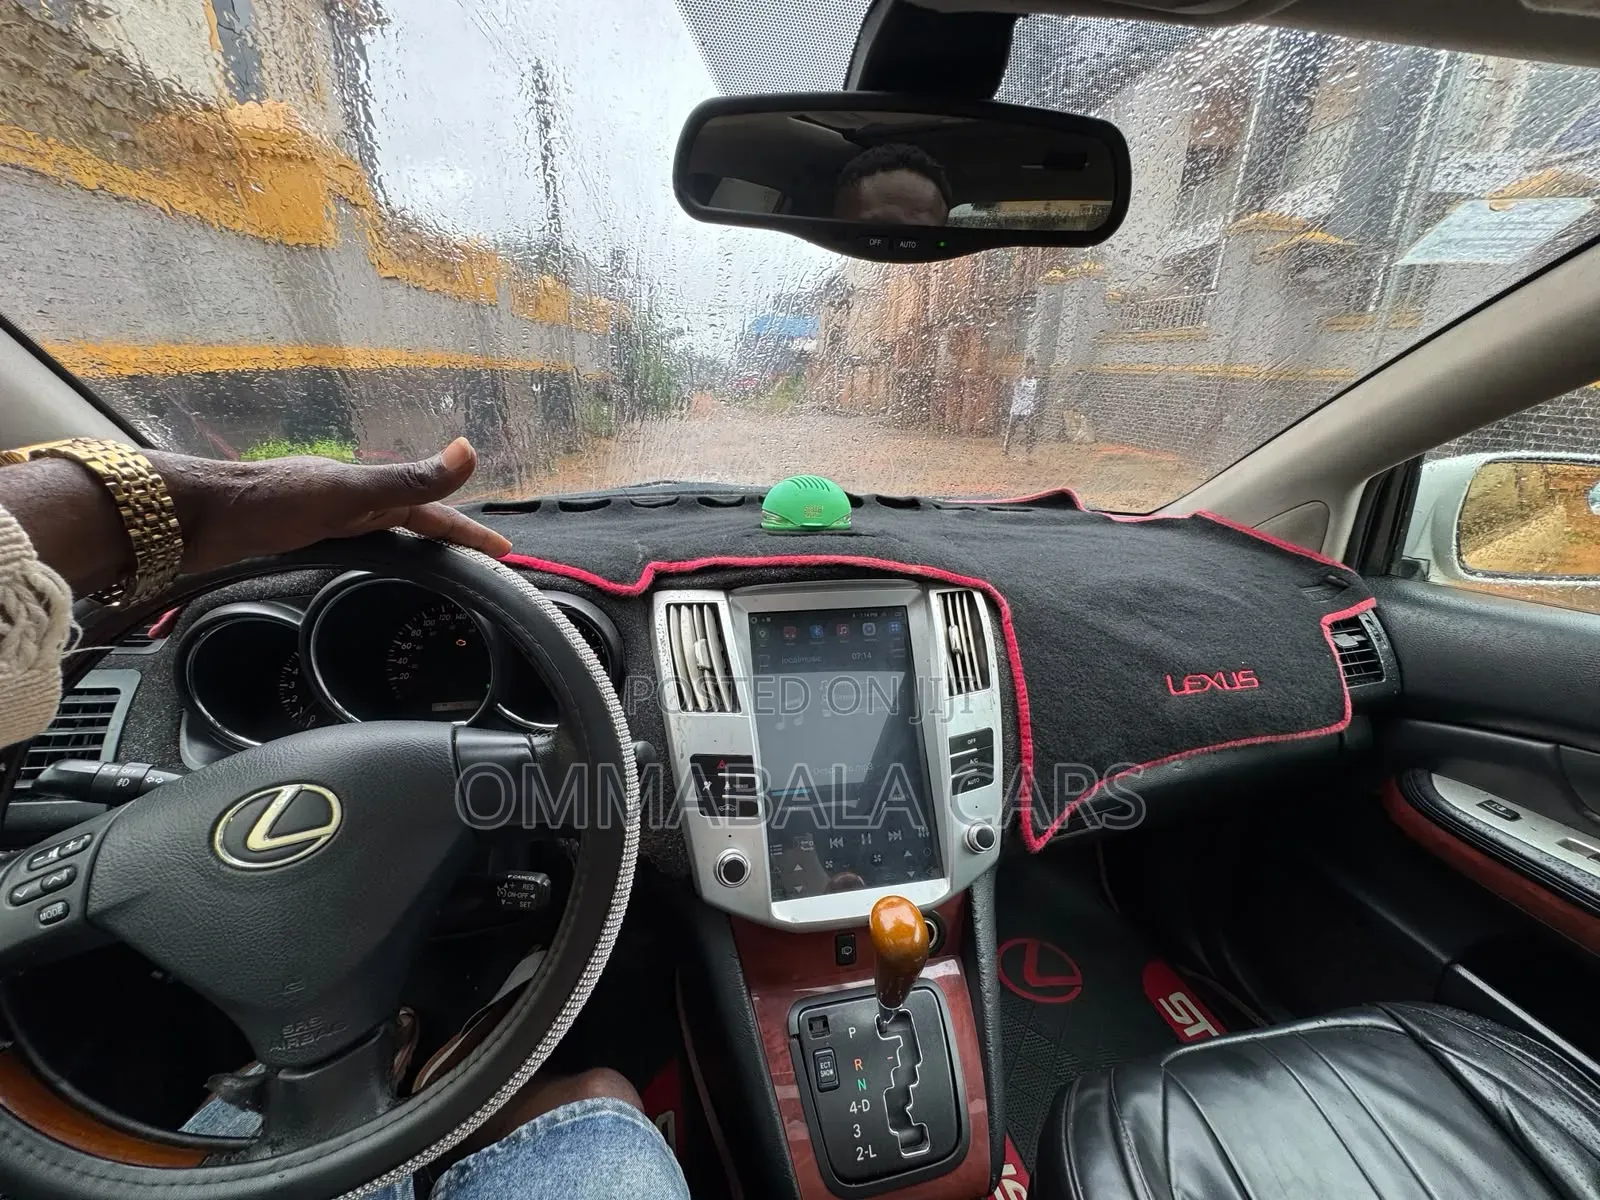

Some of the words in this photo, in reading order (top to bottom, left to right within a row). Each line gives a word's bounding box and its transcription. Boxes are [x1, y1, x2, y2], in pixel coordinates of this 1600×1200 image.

[423, 619, 435, 627] 100
[410, 629, 422, 637] 80
[401, 642, 412, 650] 60
[851, 651, 872, 660] 07:14
[397, 657, 408, 665] 40
[292, 667, 299, 675] 4
[399, 672, 409, 680] 20
[288, 681, 296, 689] 3
[1166, 668, 1261, 696] LEXUS
[291, 694, 298, 702] 2
[967, 777, 980, 785] AUTO
[522, 883, 534, 891] RES
[39, 907, 65, 921] MODE
[848, 1027, 857, 1039] P
[820, 1061, 832, 1070] ECT
[854, 1058, 864, 1071] R
[820, 1070, 834, 1078] SNOW
[857, 1078, 867, 1092] N
[849, 1099, 871, 1115] 4-D
[852, 1123, 862, 1139] 3
[855, 1144, 877, 1161] 2-L
